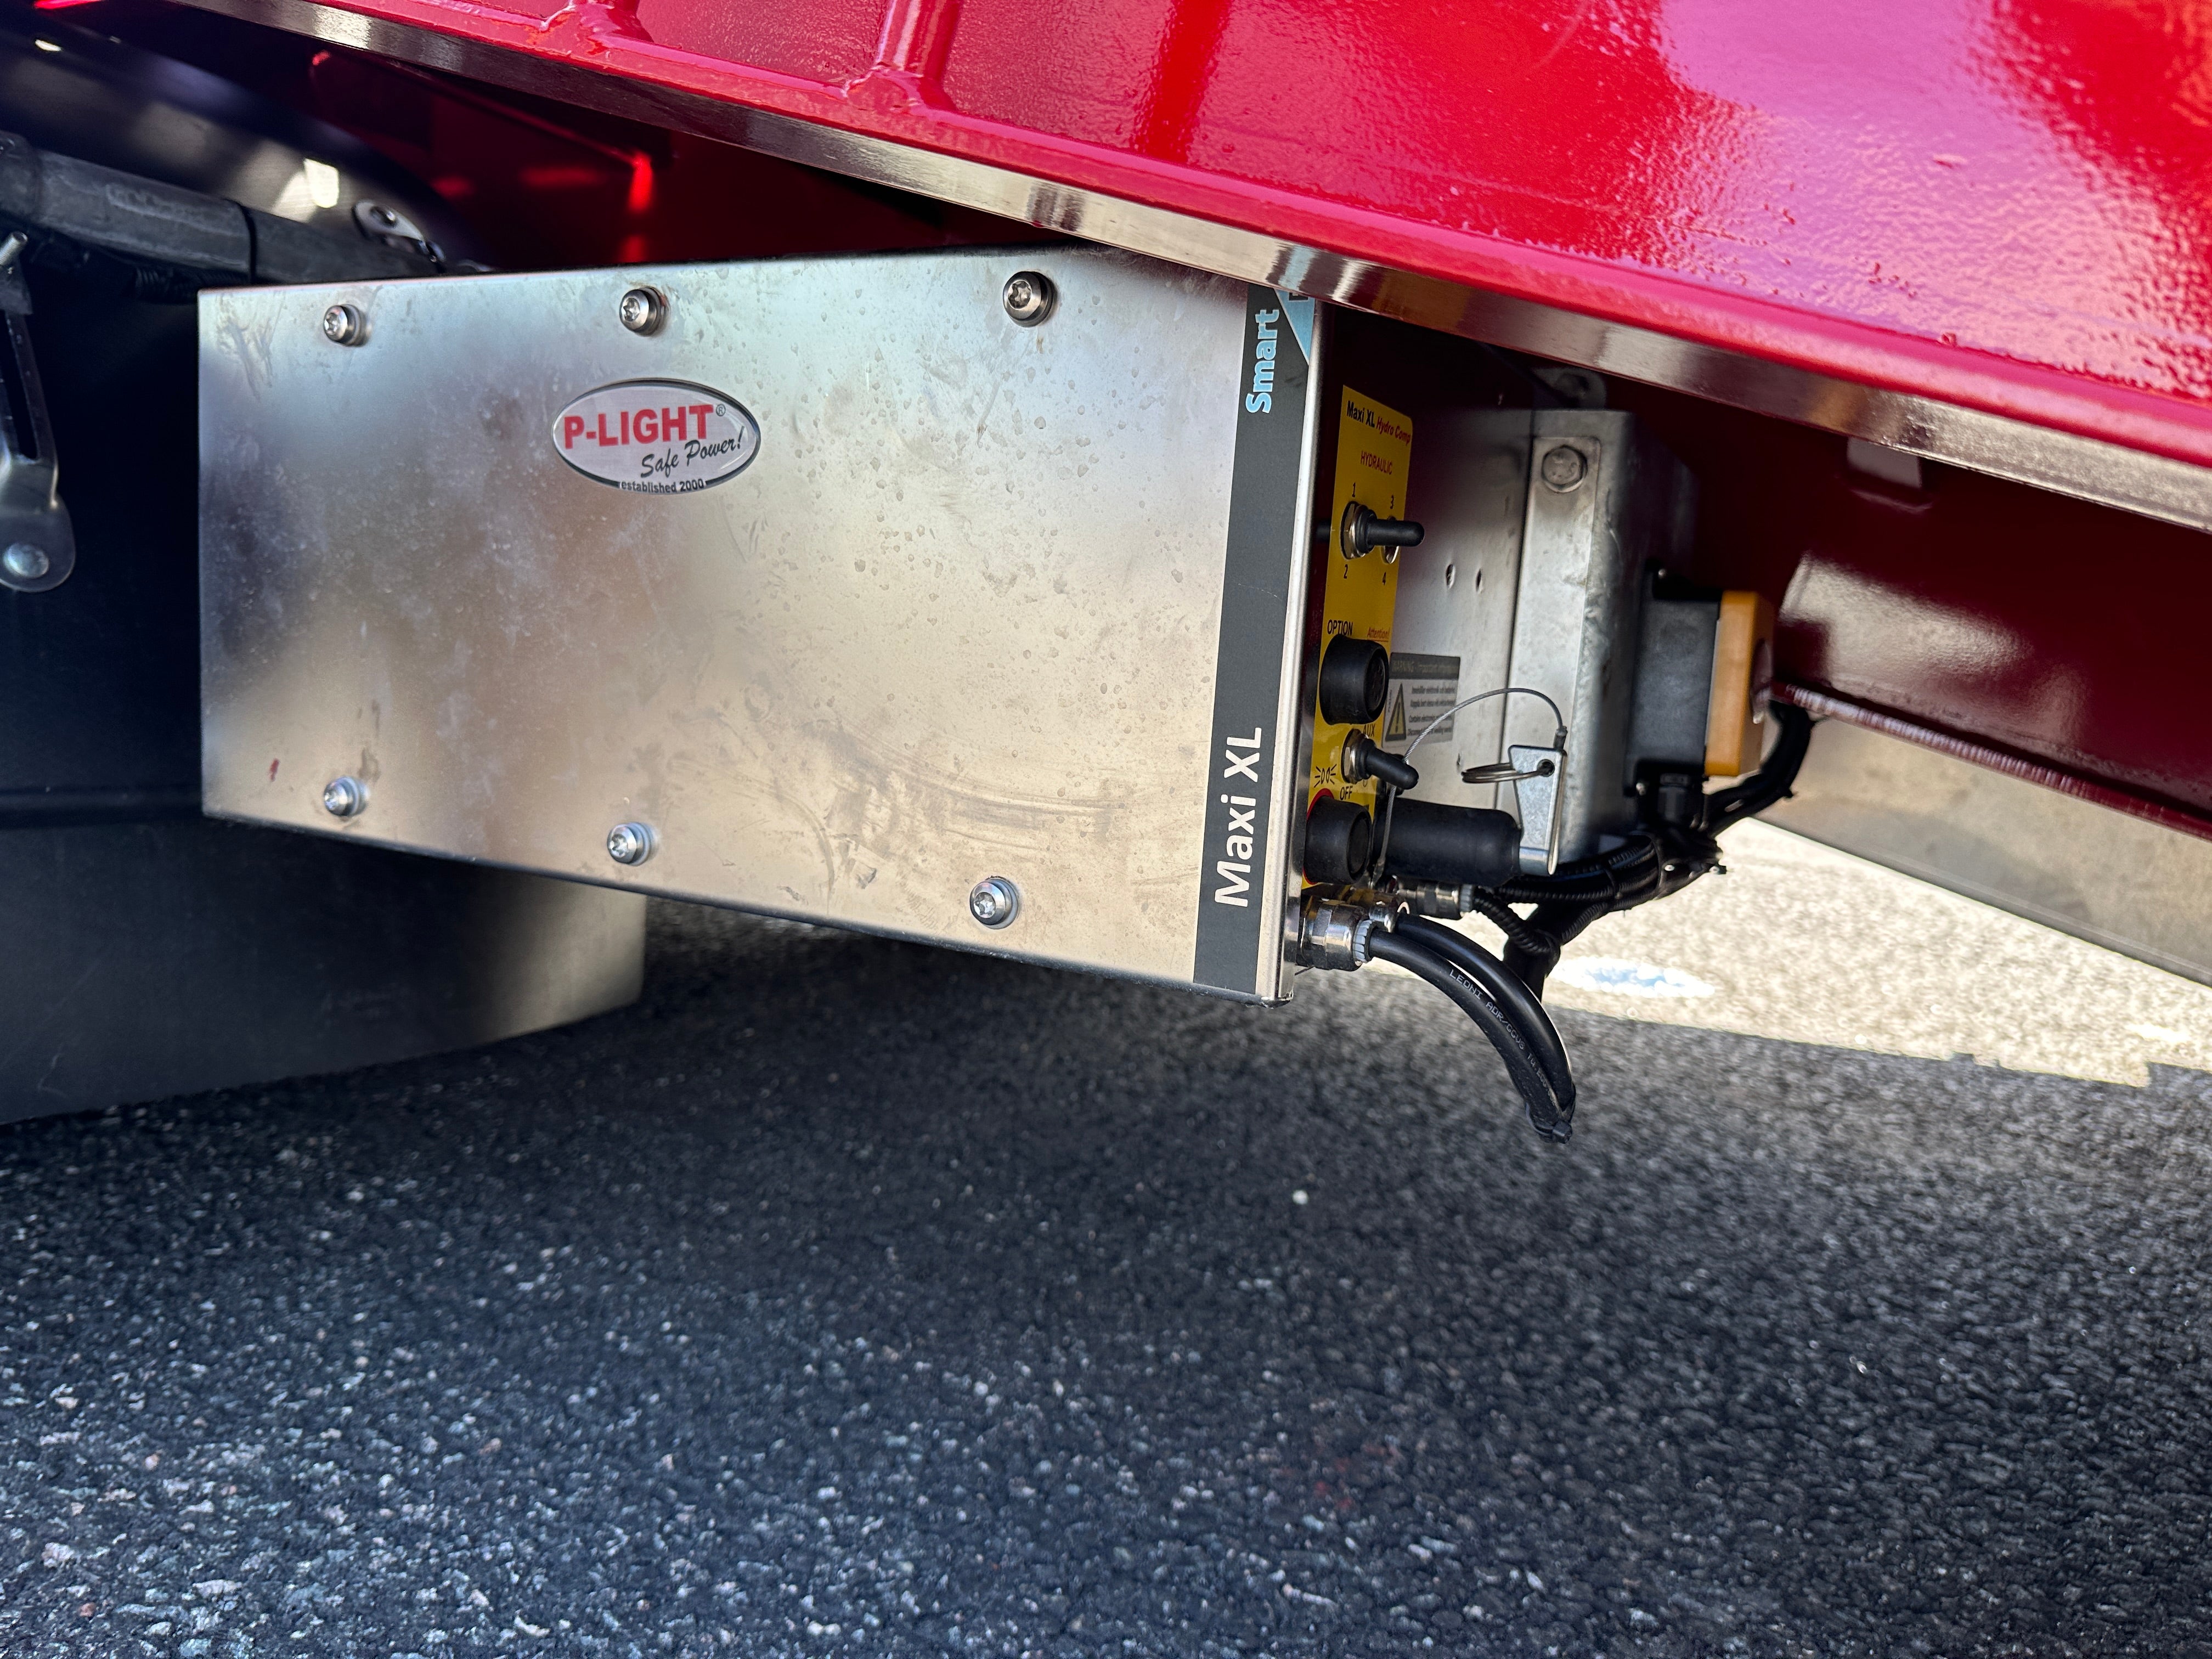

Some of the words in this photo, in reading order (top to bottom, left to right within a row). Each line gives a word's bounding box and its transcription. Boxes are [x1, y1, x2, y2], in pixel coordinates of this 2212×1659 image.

[1245, 309, 1280, 414] Smart
[1346, 400, 1365, 424] Maxi
[1366, 409, 1375, 428] XL
[1376, 416, 1394, 435] Hydro
[1395, 426, 1411, 446] Comp
[640, 448, 679, 478] Safe
[684, 425, 745, 467] Power!
[1361, 450, 1393, 475] HYDRAULIC
[621, 481, 676, 493] established
[680, 478, 704, 491] 2000
[1352, 482, 1356, 498] 1
[1390, 494, 1394, 509] 3
[1344, 564, 1348, 579] 2
[1382, 572, 1386, 585] 4
[1327, 619, 1353, 636] OPTION
[1363, 724, 1375, 737] AUX
[1224, 727, 1262, 783] XL
[1340, 786, 1353, 800] OFF
[1214, 794, 1256, 907] Maxi
[1449, 969, 1483, 1000] LEONI
